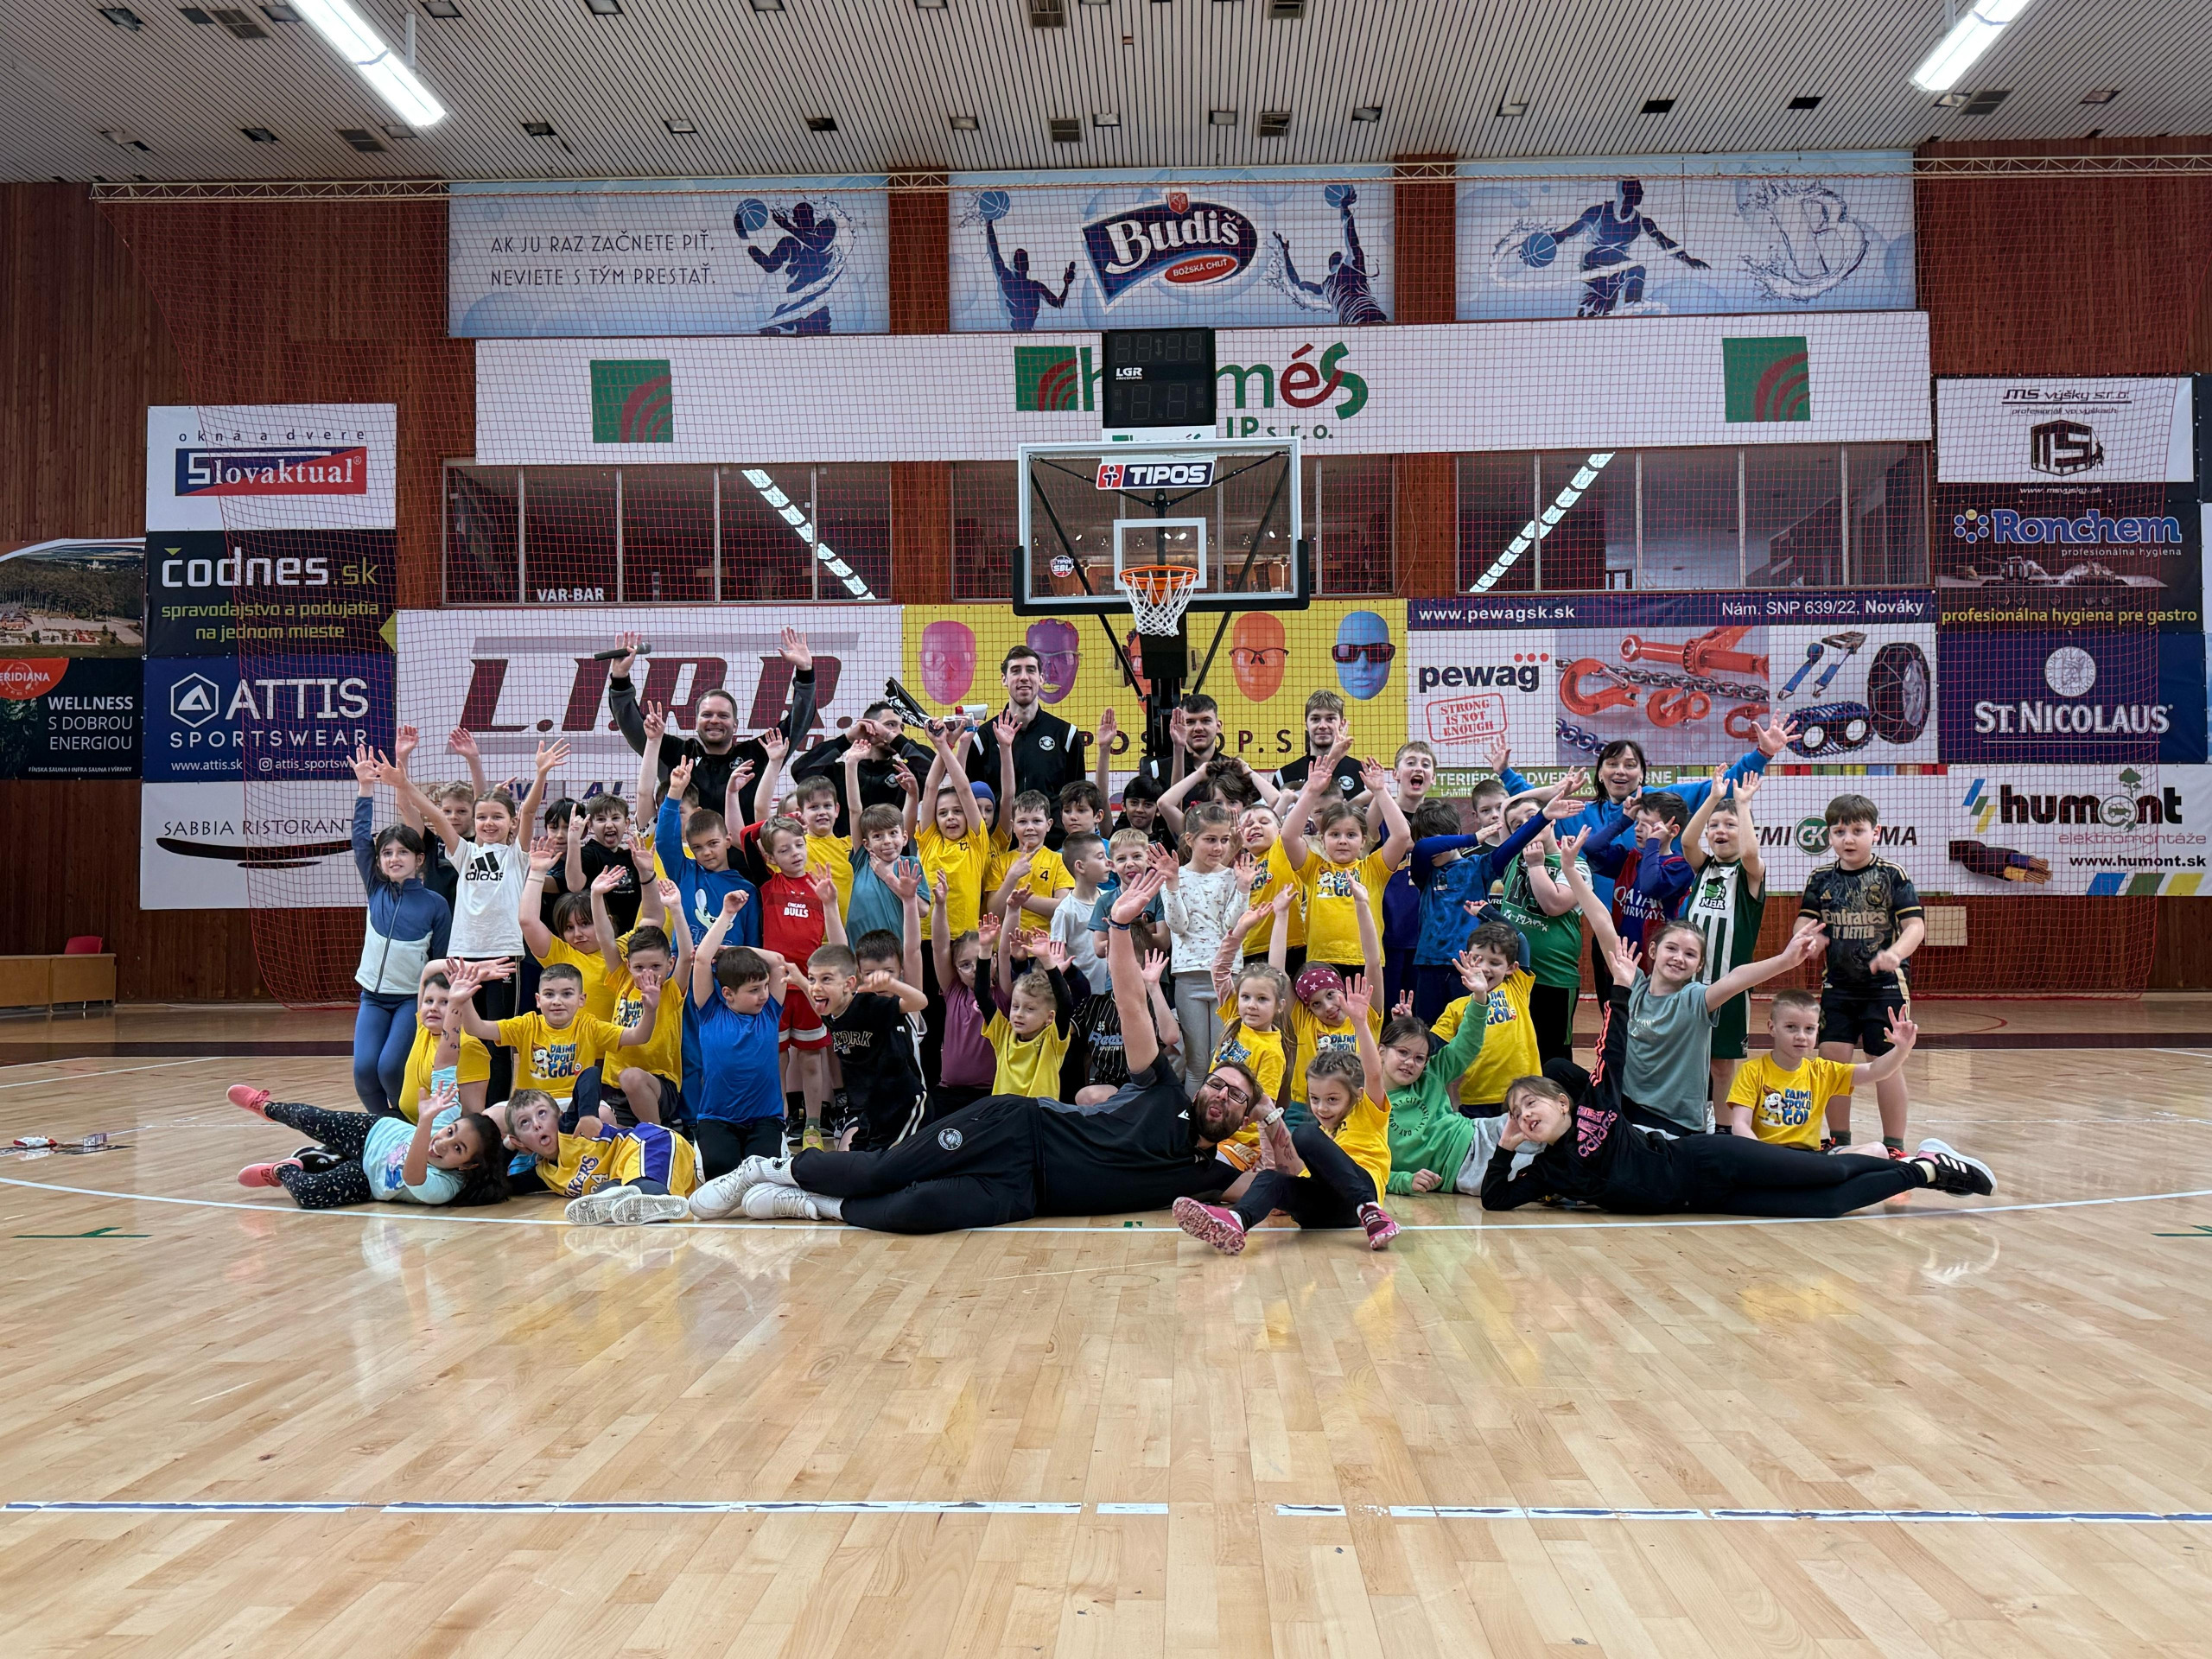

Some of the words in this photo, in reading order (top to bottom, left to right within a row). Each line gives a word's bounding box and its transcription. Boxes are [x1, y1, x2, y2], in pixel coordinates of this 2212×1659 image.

[491, 236, 515, 253] AK
[520, 235, 542, 253] JU
[550, 235, 585, 252] RAZ
[592, 230, 675, 252] ZAČNETE
[1105, 210, 1240, 275] Budiš
[491, 269, 565, 286] NEVIETE
[574, 269, 582, 286] S
[588, 264, 625, 285] TÝM
[634, 263, 716, 285] PRESTAŤ.
[1173, 262, 1205, 278] BOŽSKÁ
[1205, 257, 1228, 272] CHUŤ
[1116, 367, 1142, 376] LGR
[2044, 389, 2089, 401] výšky
[179, 429, 241, 442] okná
[260, 433, 268, 442] a
[286, 429, 365, 442] dvere
[188, 450, 354, 485] Slovaktual
[1128, 464, 1207, 486] TIPOS
[1991, 509, 2182, 543] Ronchem
[2062, 547, 2134, 557] profesionálna
[2139, 547, 2182, 557] hygiena
[537, 588, 604, 602] VAR-BAR
[161, 601, 280, 621] spravodajstvo
[284, 605, 295, 616] a
[299, 601, 378, 620] podujatia
[1418, 606, 1575, 622] www.pewagsk.sk
[1723, 601, 1759, 616] Nám.
[1766, 601, 1800, 615] SNP
[1866, 600, 1923, 615] Nováky
[1942, 608, 2048, 626] profesionálna
[2052, 608, 2113, 625] hygiena
[2118, 612, 2143, 623] pre
[2147, 609, 2197, 625] gastro
[196, 626, 216, 639] na
[219, 625, 283, 642] jednom
[288, 625, 345, 639] mieste
[1419, 663, 1541, 692] pewag
[48, 696, 133, 710] WELLNESS
[225, 678, 369, 720] ATTIS
[1440, 699, 1490, 715] STRONG
[48, 716, 57, 730] S
[62, 716, 132, 730] DOBROU
[1446, 715, 1458, 725] IS
[1462, 711, 1486, 723] NOT
[1443, 721, 1494, 736] ENOUGH
[50, 736, 131, 750] ENERGIOU
[170, 729, 367, 748] SPORTSWEAR
[171, 759, 243, 771] www.attis.sk
[275, 758, 352, 771] attis_sportsw
[164, 821, 234, 836] SABBIA
[243, 819, 353, 836] RISTORAN
[2059, 833, 2207, 844] elektromontáže
[2070, 855, 2206, 867] www.humont.sk
[466, 869, 503, 881] adidas
[1039, 870, 1049, 881] 4
[784, 906, 809, 918] BULLS
[1621, 905, 1666, 922] AIRWAYS
[1578, 1109, 1618, 1157] adidas
